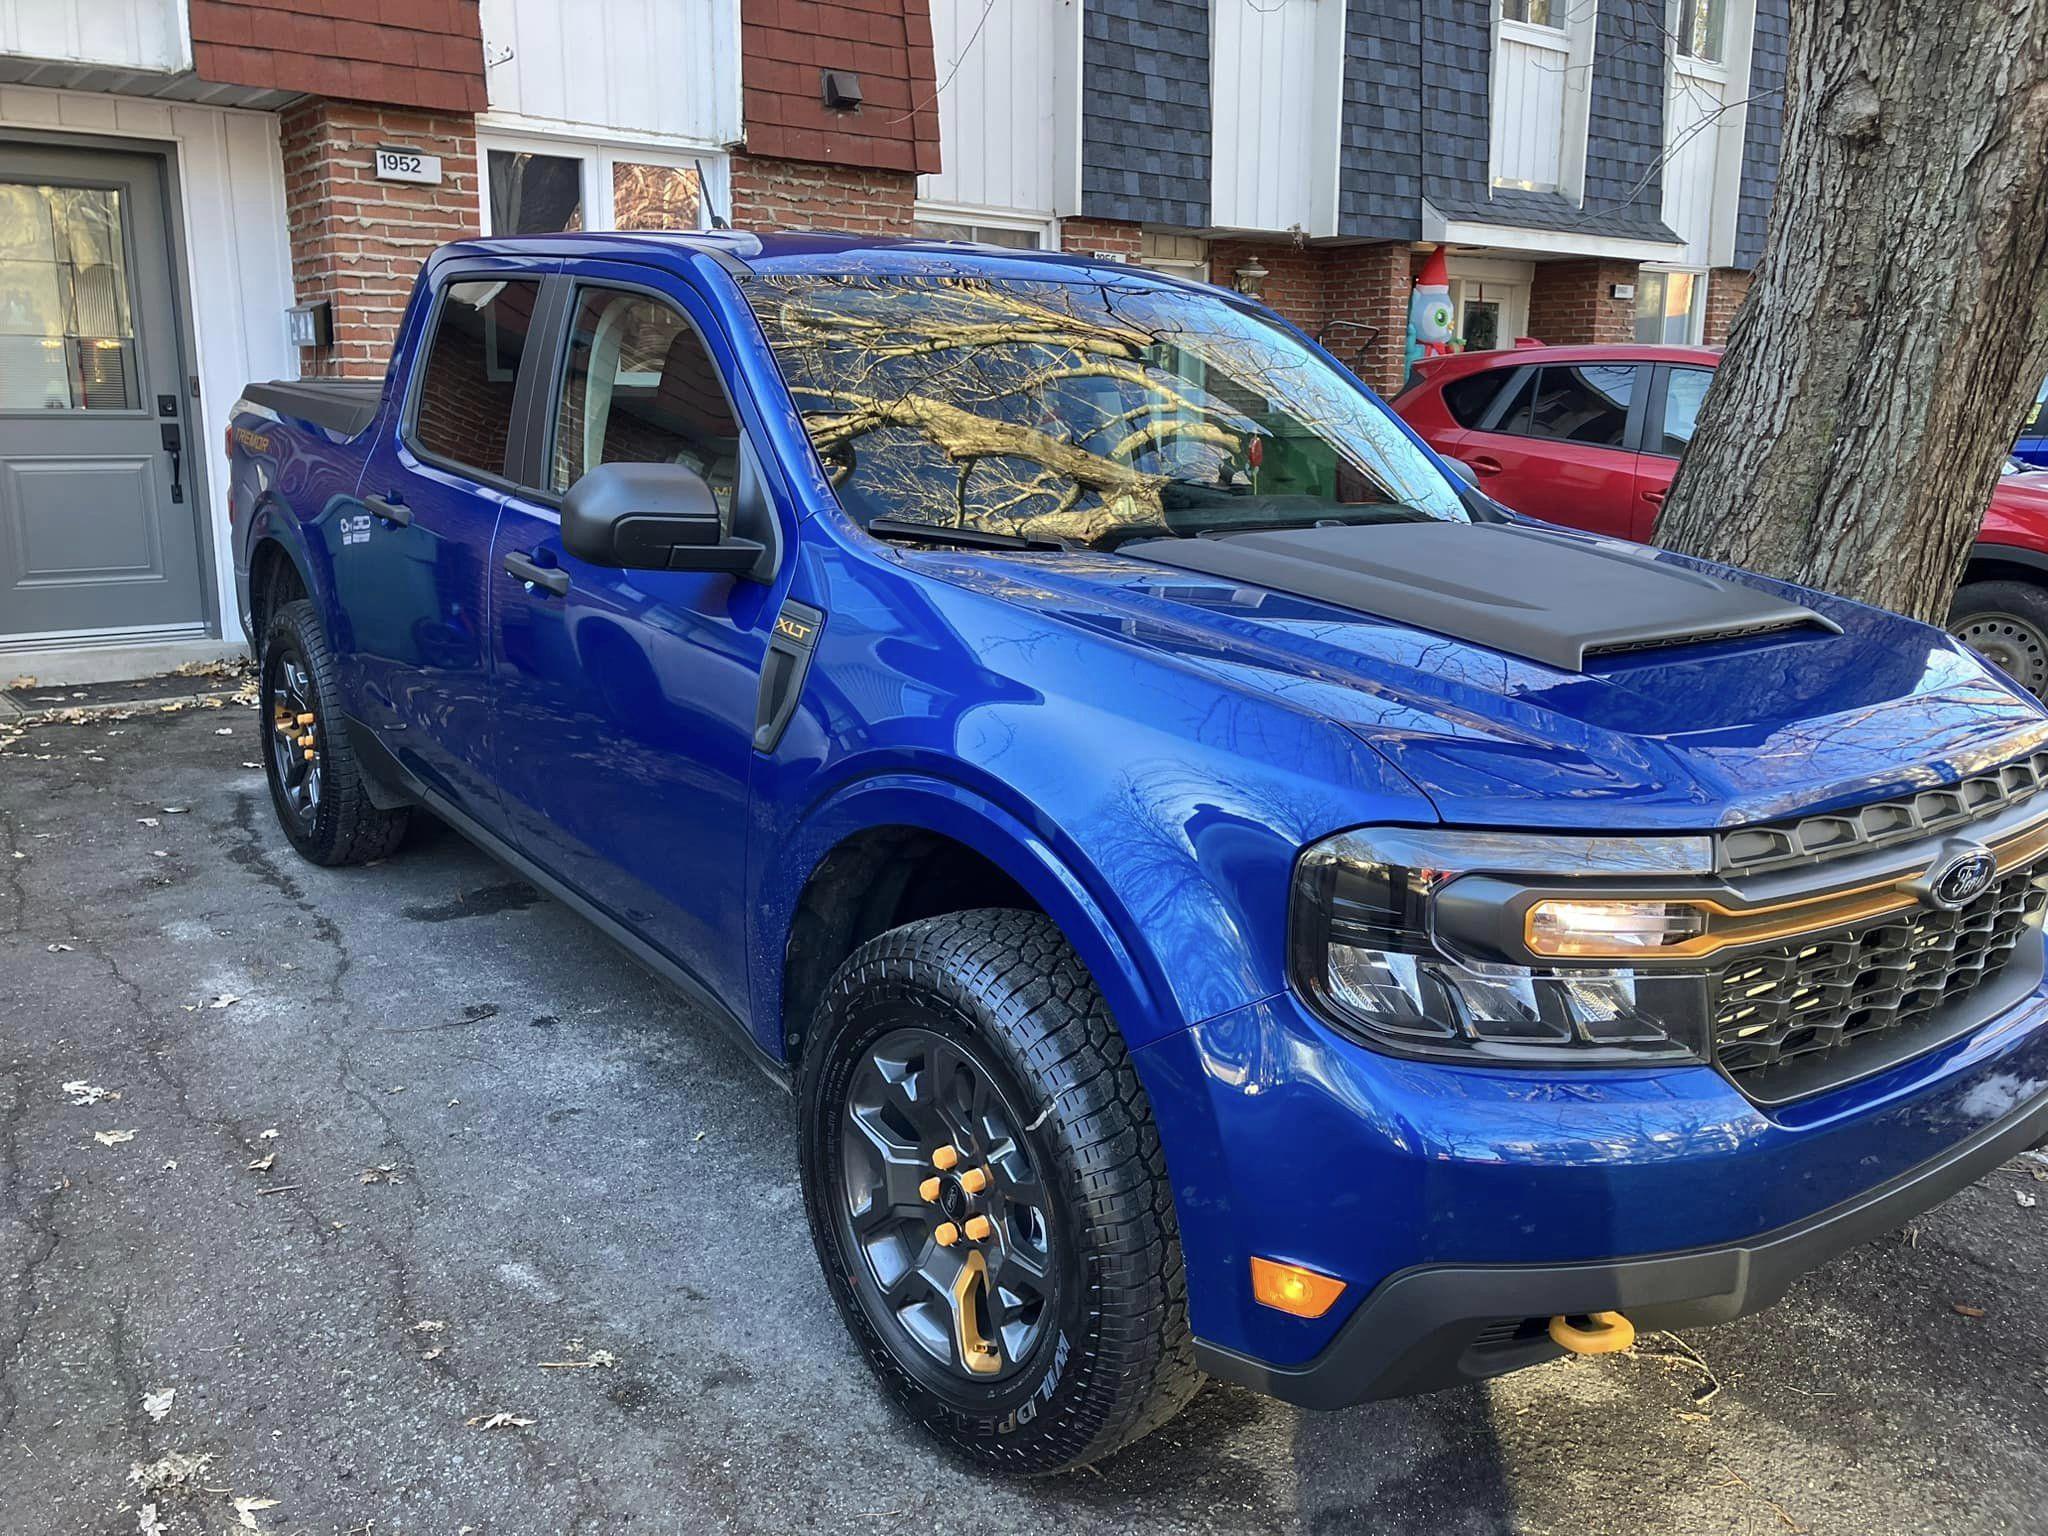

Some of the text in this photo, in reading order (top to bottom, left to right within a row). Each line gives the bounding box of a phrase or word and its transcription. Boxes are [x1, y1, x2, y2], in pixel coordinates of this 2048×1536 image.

[380, 154, 422, 173] 1952
[236, 428, 270, 452] TREMOR
[775, 617, 811, 638] XLT
[1952, 862, 1989, 898] Ford
